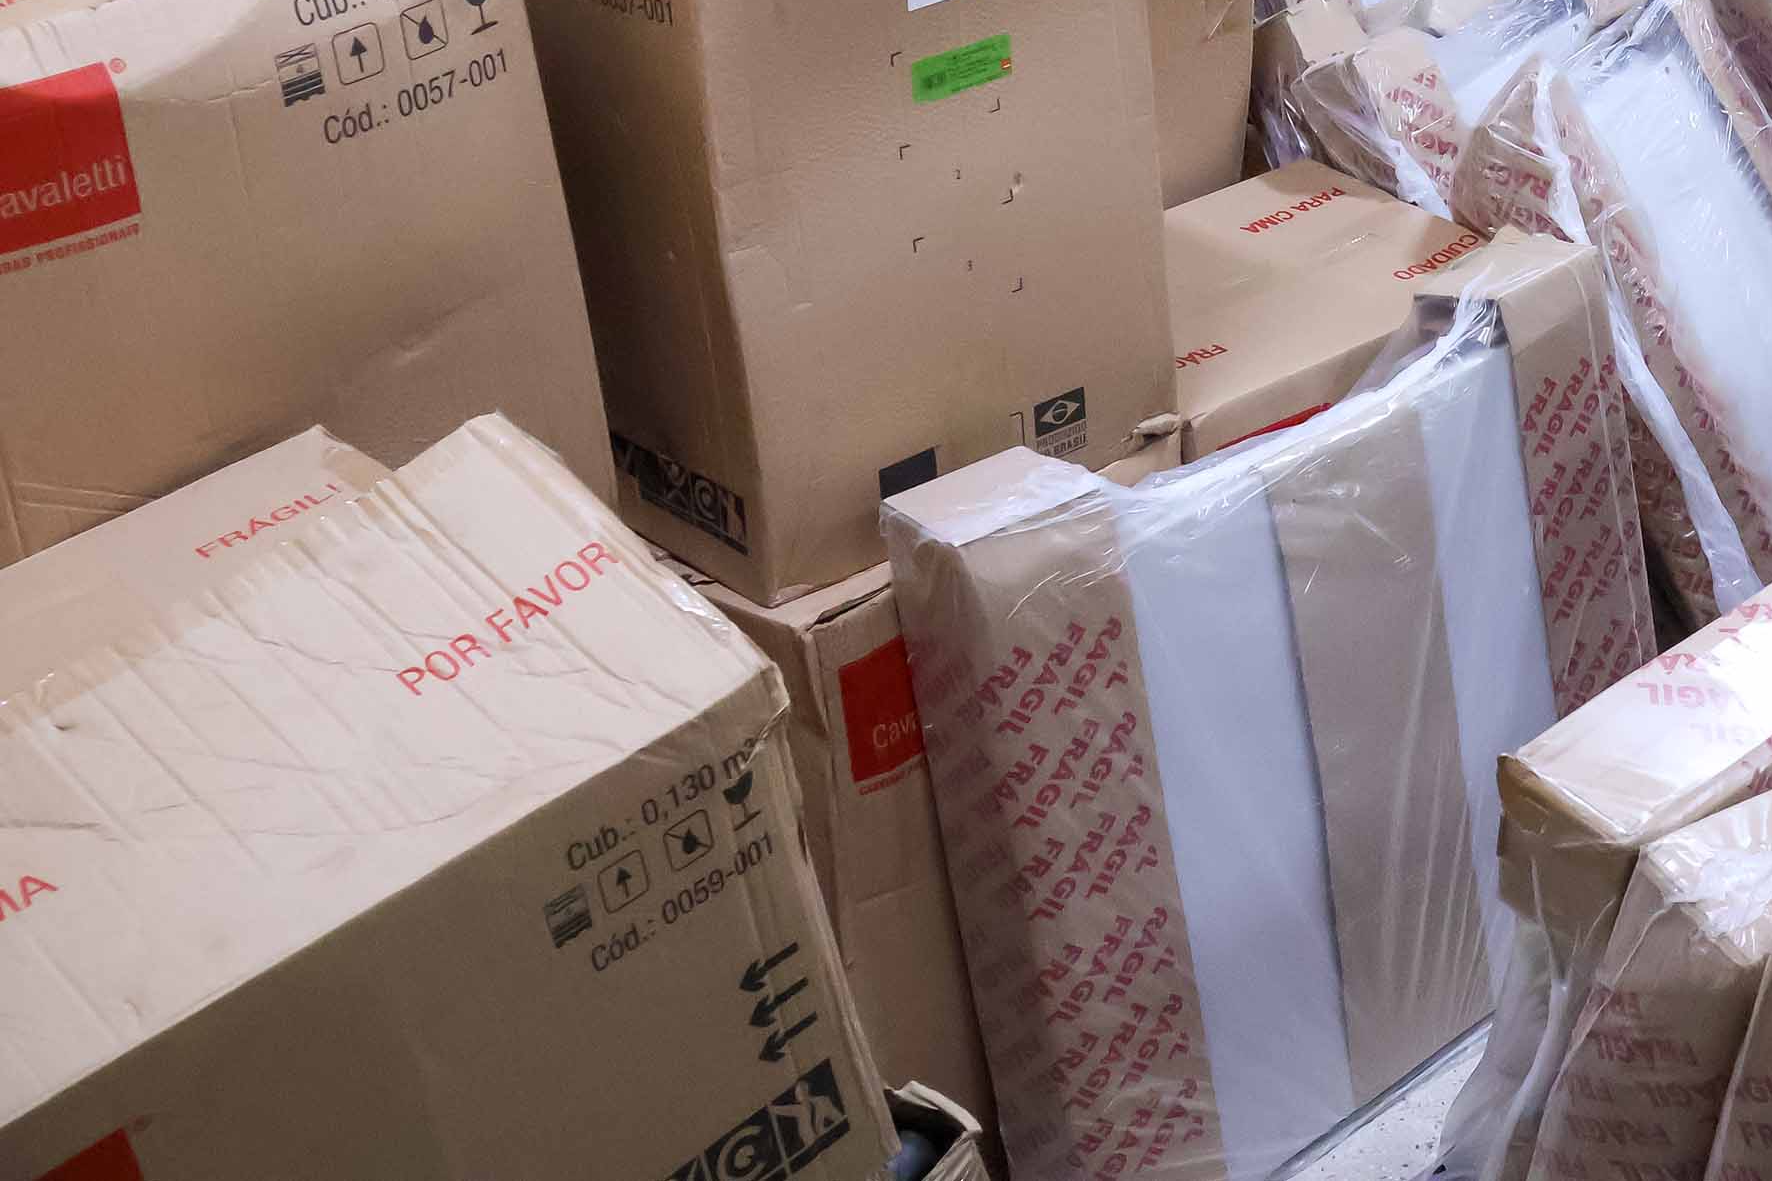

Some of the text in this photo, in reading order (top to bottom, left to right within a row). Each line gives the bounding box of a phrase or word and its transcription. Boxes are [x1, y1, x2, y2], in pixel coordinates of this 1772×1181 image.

[323, 47, 507, 144] Cód.: 0057-001
[0, 155, 127, 219] avaletti
[1240, 186, 1347, 234] PARA CIMA
[1393, 233, 1480, 281] CUIDADO
[1570, 355, 1615, 437] RÁGIL
[397, 540, 620, 699] POR FAVOR
[1054, 615, 1122, 715] RÁGIL
[1070, 712, 1136, 809] RÁGIL
[566, 825, 637, 870] Cub.:
[641, 764, 716, 827] 0,130
[1084, 804, 1150, 899] RÁGIL
[591, 831, 773, 972] Cód.: 0059-001
[1104, 907, 1168, 1004] RÁGIL
[1120, 994, 1184, 1089] RÁGIL
[1135, 1078, 1197, 1172] RÁGIL
